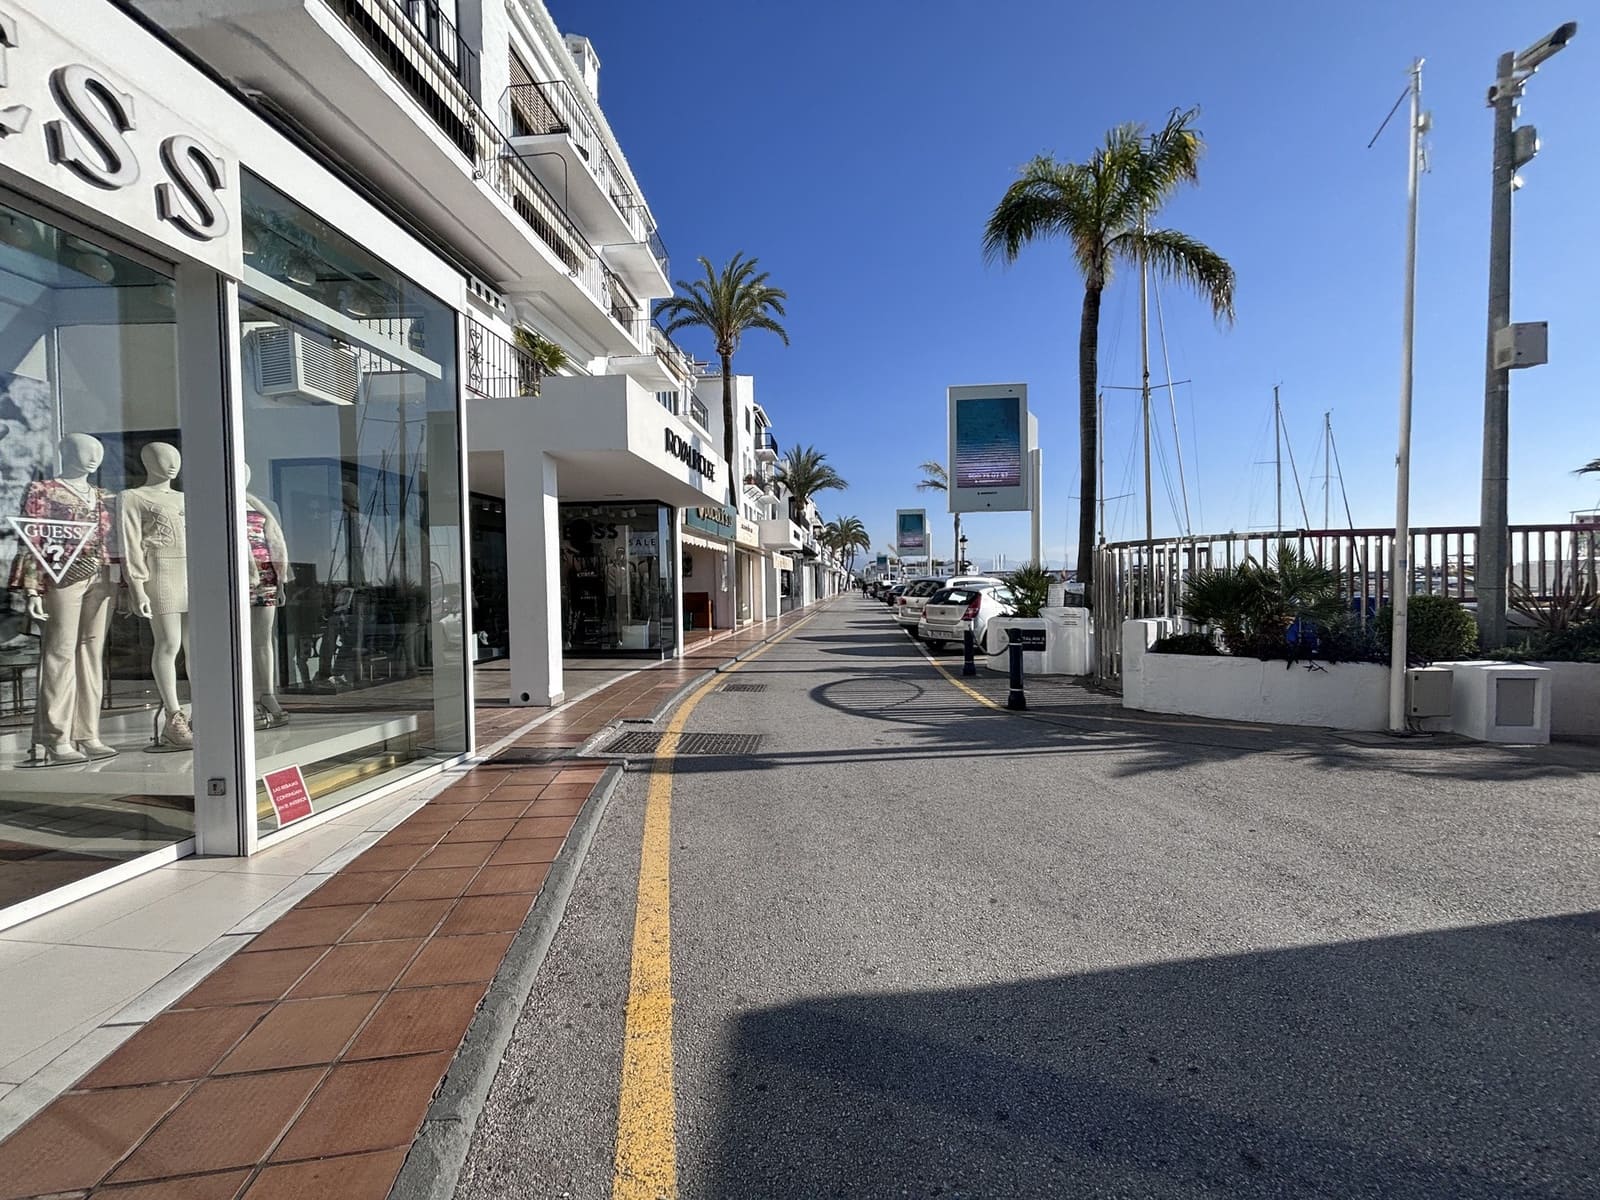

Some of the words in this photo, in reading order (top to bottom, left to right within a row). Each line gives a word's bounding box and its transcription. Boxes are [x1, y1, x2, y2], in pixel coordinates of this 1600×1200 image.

[24, 523, 83, 540] GUESS
[563, 523, 618, 540] BSS
[628, 537, 657, 547] SALE
